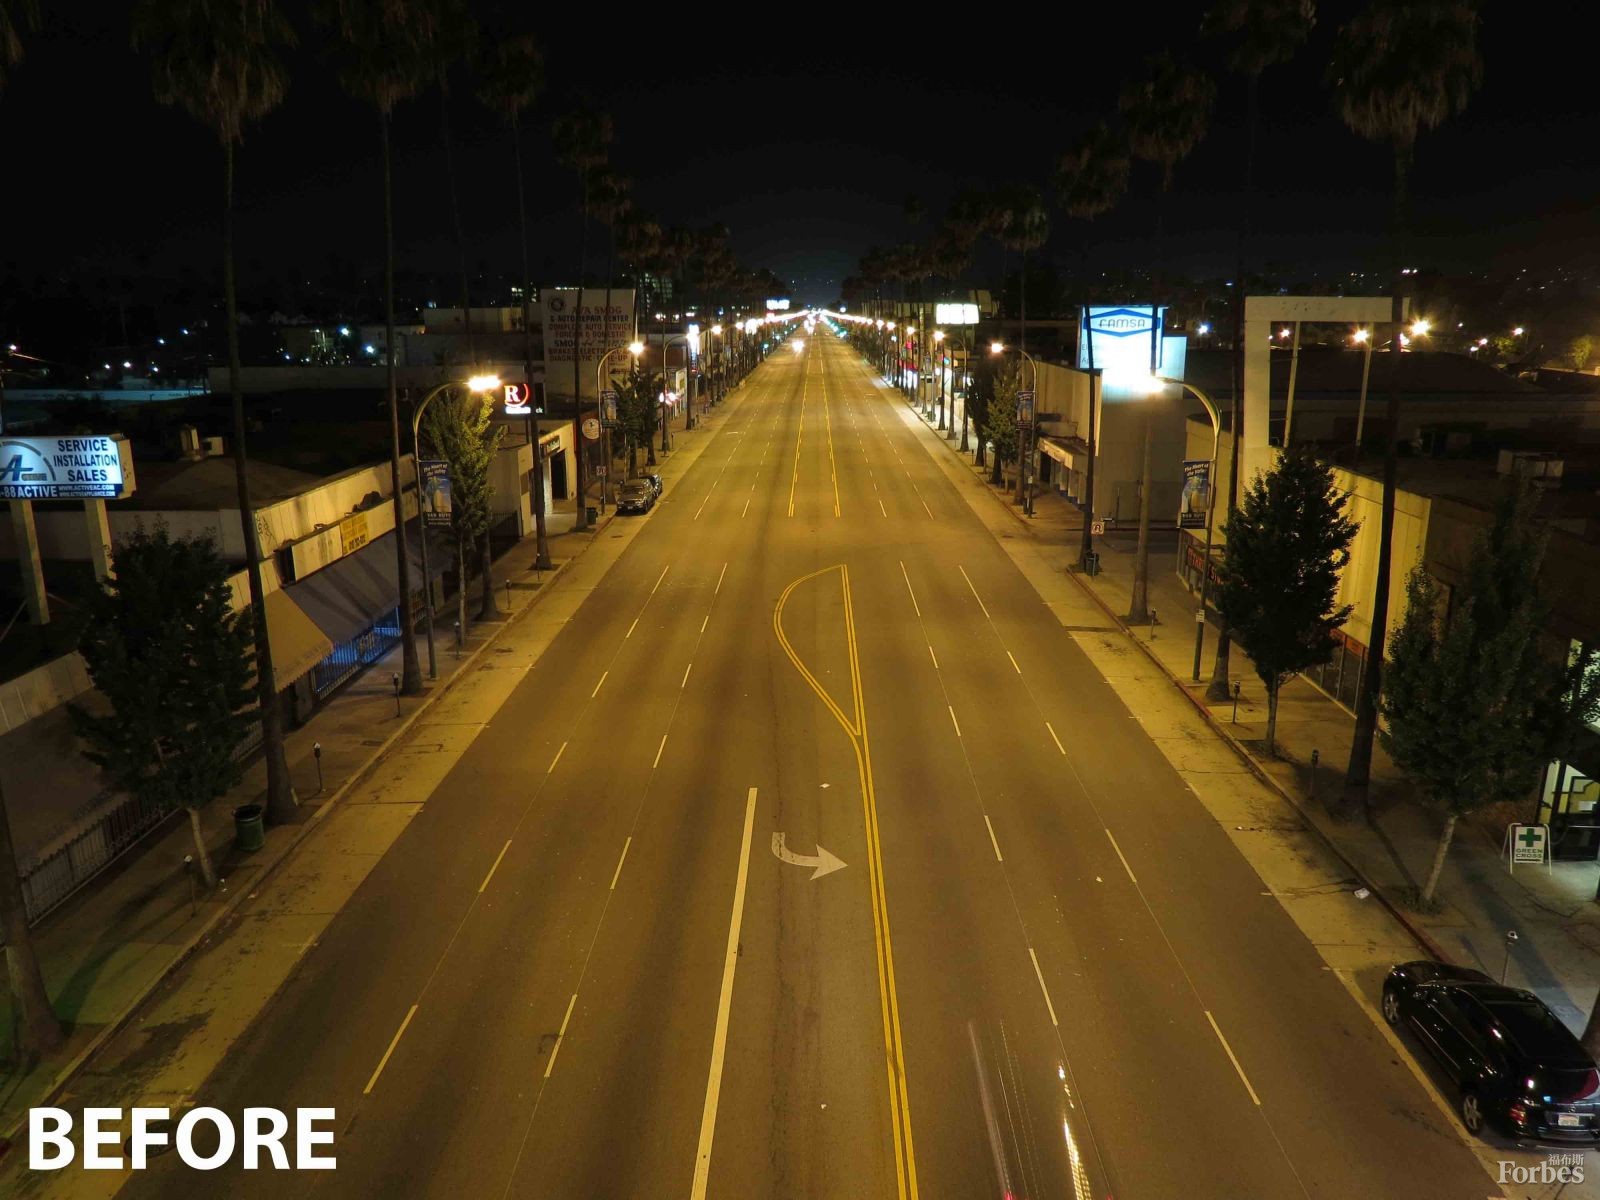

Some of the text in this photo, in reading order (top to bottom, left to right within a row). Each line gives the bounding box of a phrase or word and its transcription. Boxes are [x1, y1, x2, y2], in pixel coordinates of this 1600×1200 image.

[594, 306, 622, 314] SMOG
[58, 439, 108, 451] SERVICE
[53, 454, 118, 466] INSTALLATION
[67, 470, 108, 481] SALES
